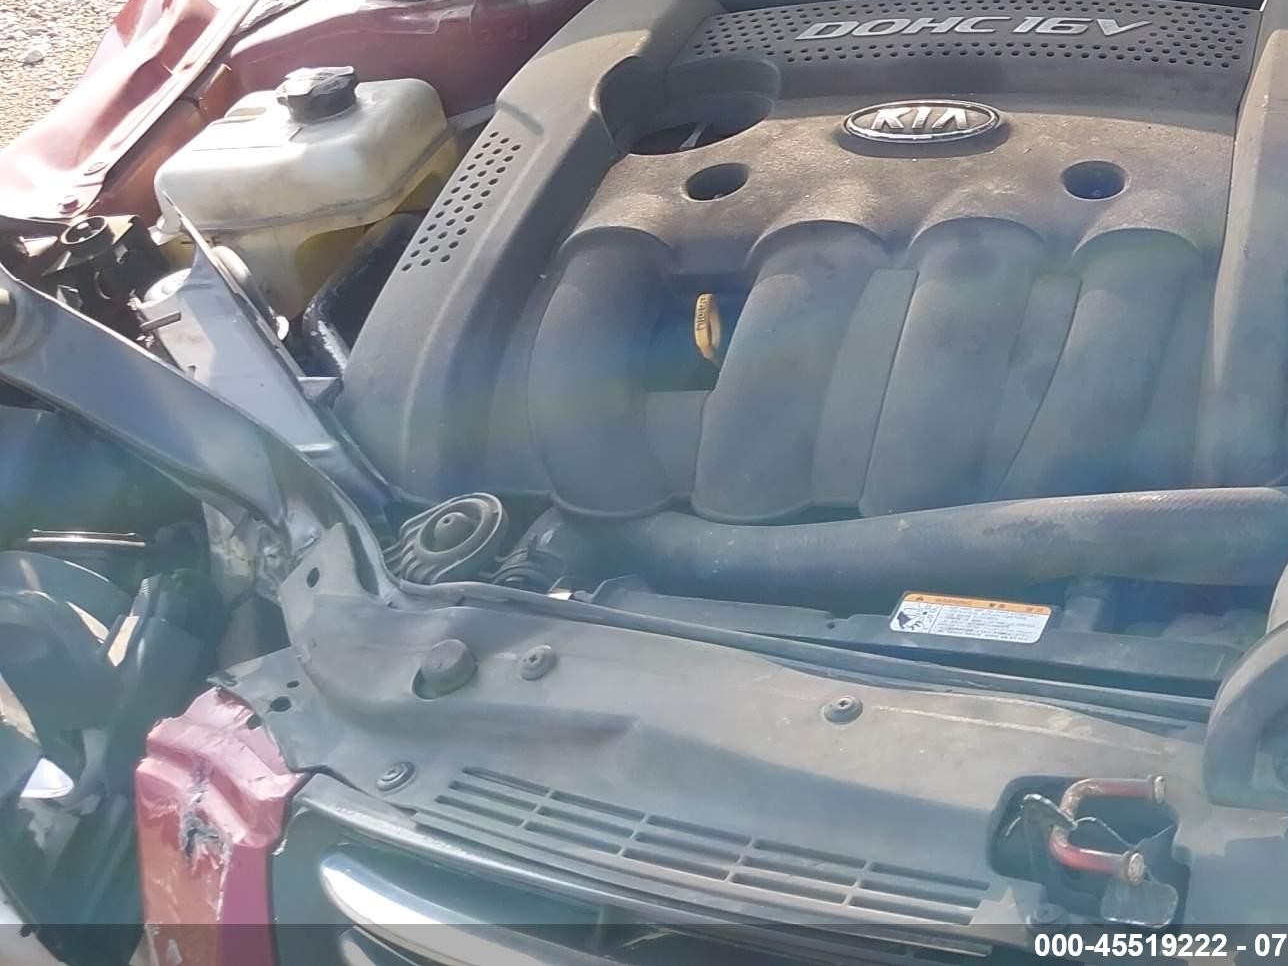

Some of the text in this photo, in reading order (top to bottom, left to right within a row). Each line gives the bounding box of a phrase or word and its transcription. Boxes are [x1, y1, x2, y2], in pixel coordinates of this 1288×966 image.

[795, 16, 1152, 41] DOHC 16V
[872, 106, 969, 131] KIA
